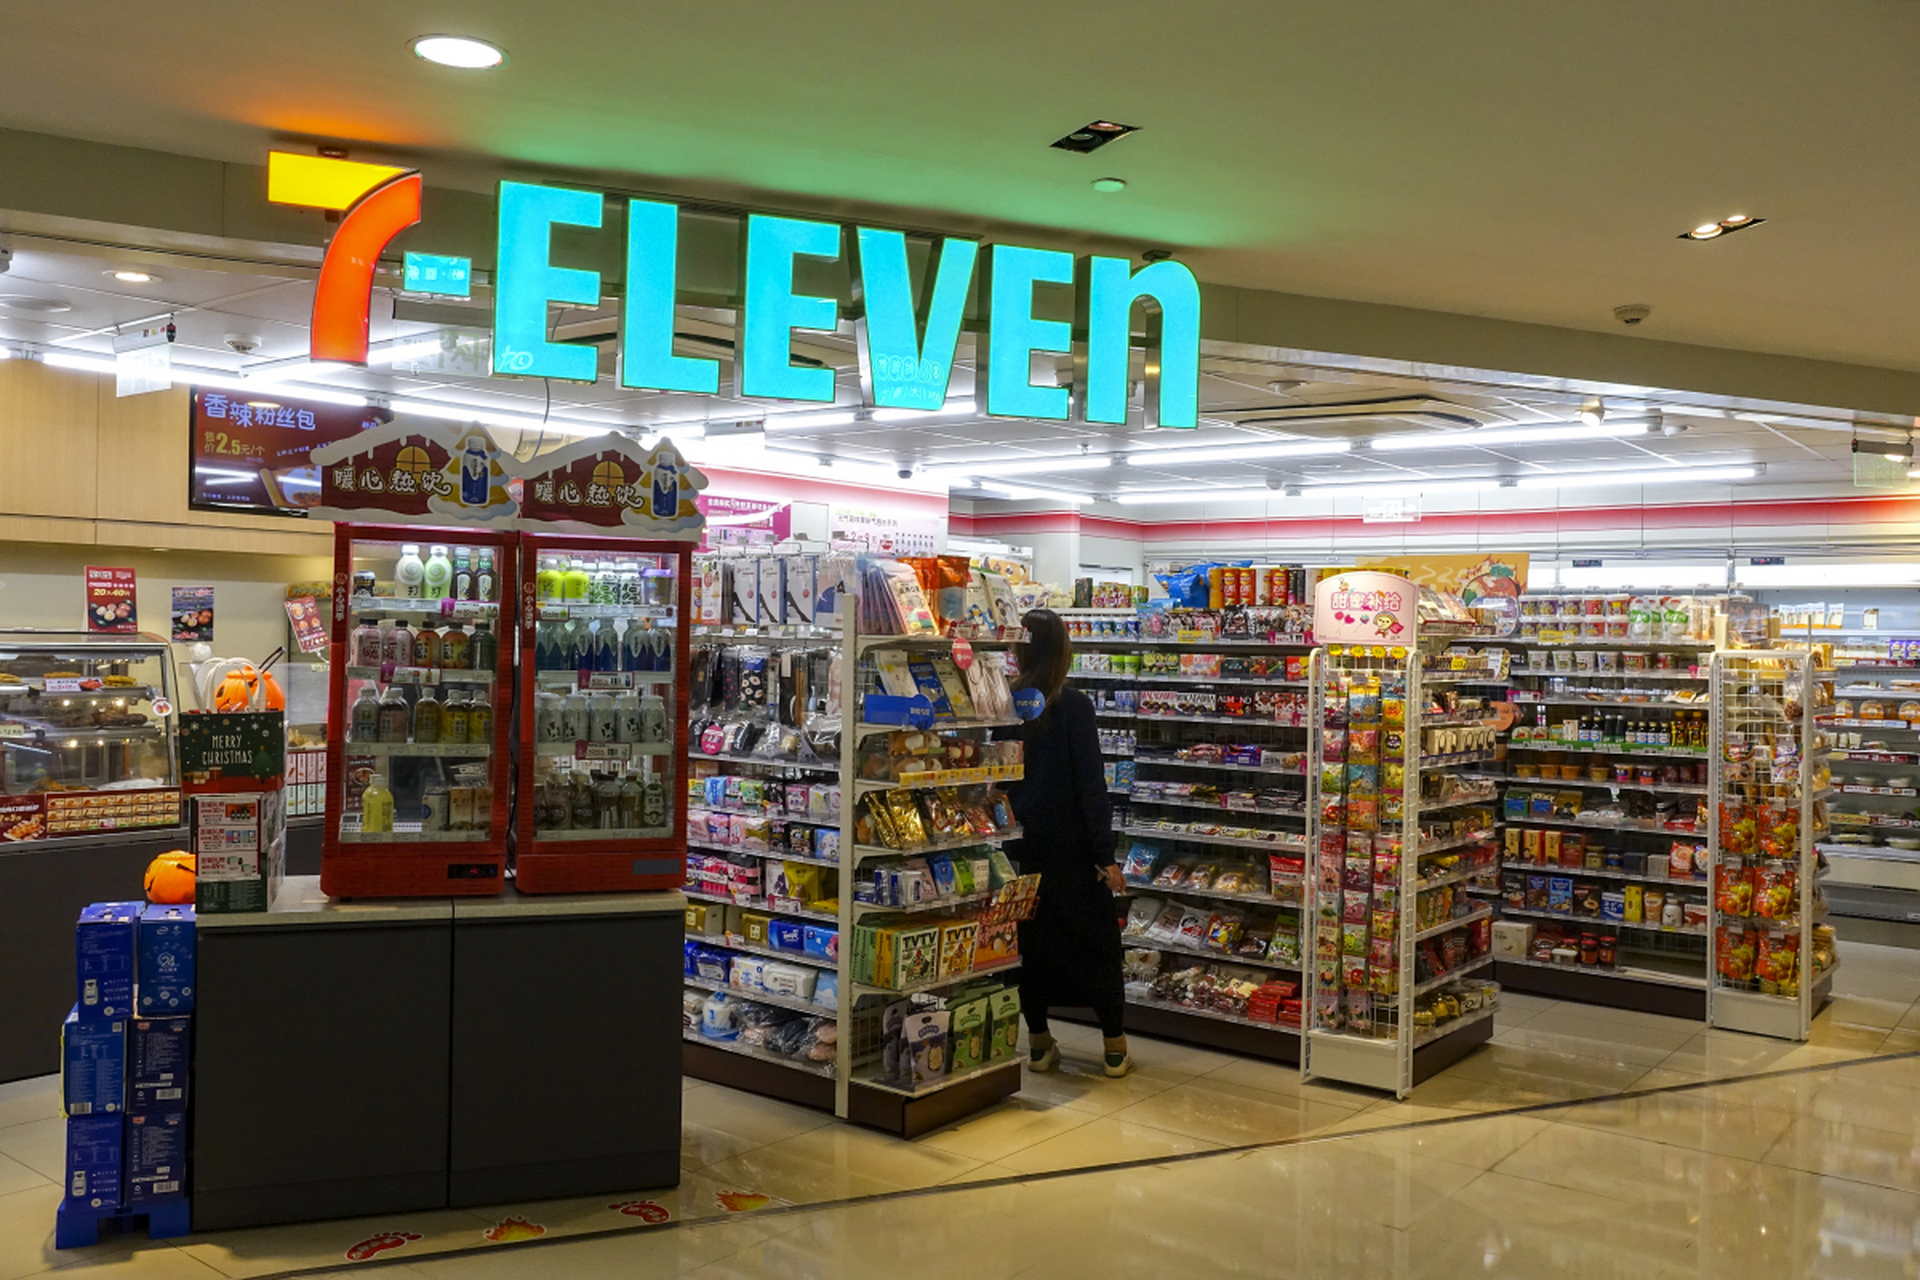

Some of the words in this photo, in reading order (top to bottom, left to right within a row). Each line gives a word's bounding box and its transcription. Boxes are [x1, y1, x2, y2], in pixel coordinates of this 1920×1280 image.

[204, 393, 316, 431] 香辣粉丝包
[1331, 591, 1403, 612] 甜蜜补给
[212, 734, 243, 749] MERRY
[202, 750, 254, 766] CHRISTMAS
[902, 931, 938, 950] TVTV
[944, 924, 979, 942] TVTV
